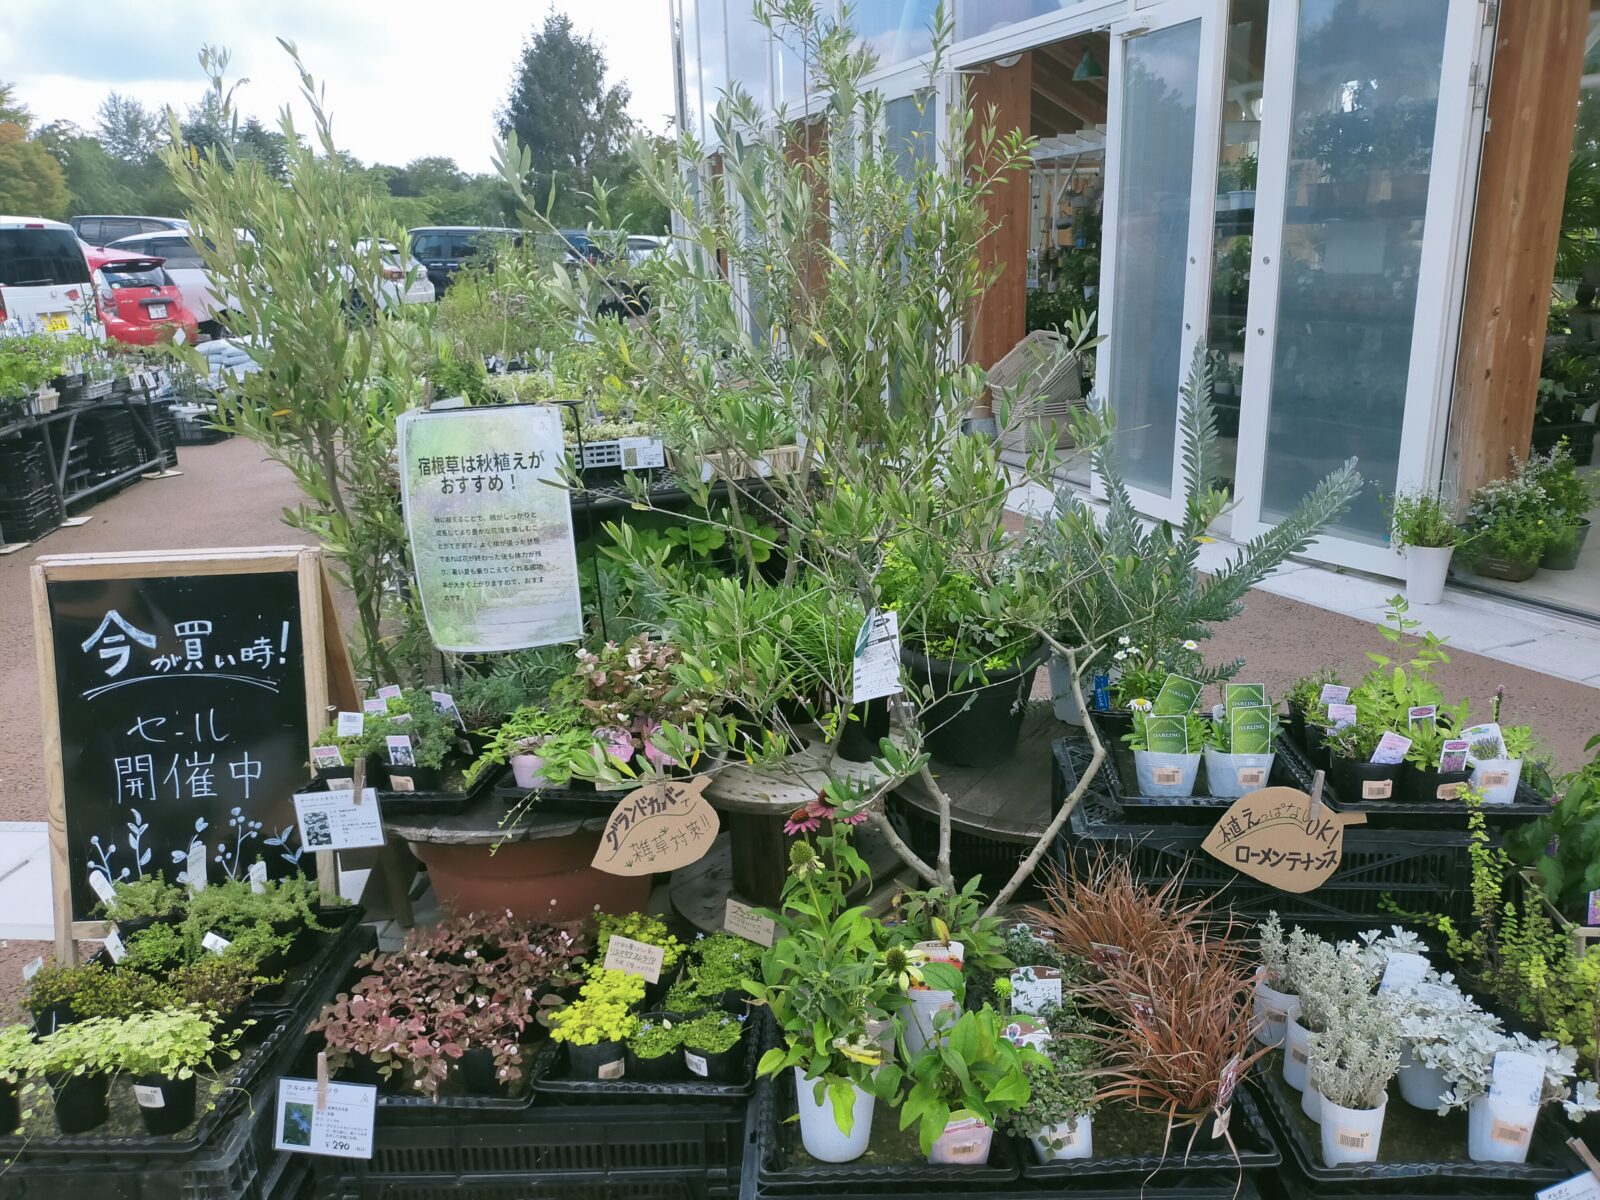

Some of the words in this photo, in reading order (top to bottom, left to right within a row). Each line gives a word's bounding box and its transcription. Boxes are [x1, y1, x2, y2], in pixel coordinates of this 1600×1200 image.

[418, 449, 545, 477] 宿根草は秋植えが
[441, 474, 516, 494] おすすめ！
[81, 609, 290, 677] 今が買い時!
[1167, 688, 1191, 700] DARLING
[127, 708, 229, 743] セール
[114, 751, 262, 804] 開催中
[1235, 845, 1338, 871] ローメンテナンス
[287, 1084, 339, 1094] ツルニチニソウ
